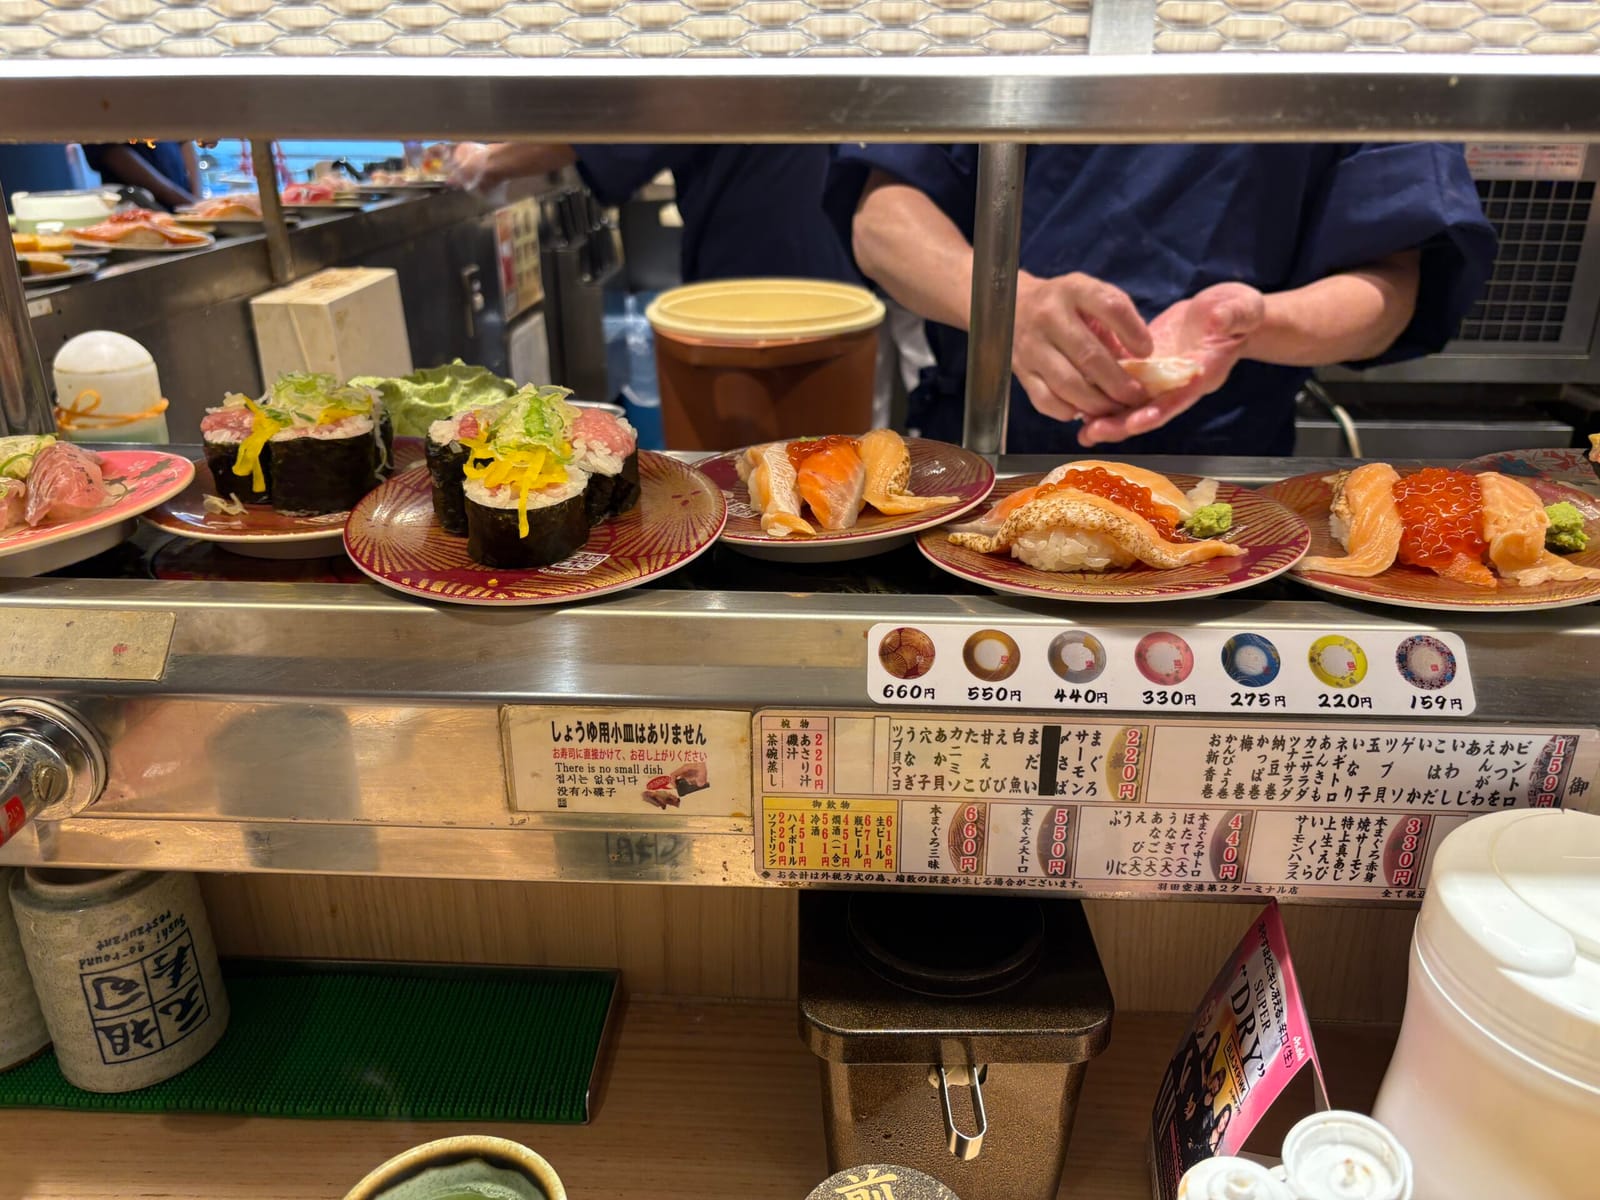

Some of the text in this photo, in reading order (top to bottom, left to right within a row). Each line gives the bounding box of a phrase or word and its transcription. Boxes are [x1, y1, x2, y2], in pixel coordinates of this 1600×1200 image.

[882, 683, 935, 700] 660円
[967, 686, 1021, 702] 550円
[1054, 688, 1108, 704] 440円
[1142, 690, 1197, 707] 330円
[1229, 692, 1286, 708] 275円
[1317, 693, 1373, 709] 220円
[1409, 694, 1463, 711] 159円
[550, 720, 707, 746] しょうゆ用小皿はありません
[552, 747, 708, 763] お寿司に直接かけて、お召し上がりください
[766, 733, 779, 787] 茶碗蒸し
[786, 734, 799, 760] 磯汁
[799, 734, 812, 787] あさり汁
[814, 733, 824, 790] 220円
[891, 725, 903, 791] ツブ貝マヨ
[904, 726, 917, 791] うなぎ
[918, 727, 932, 791] 穴子
[933, 727, 948, 791] あか貝
[947, 726, 963, 792] カニミソ
[963, 727, 979, 793] たこ
[979, 728, 994, 793] 甘えび
[993, 728, 1008, 793] えび
[1009, 727, 1025, 794] 白魚
[1024, 729, 1041, 795] まだい
[1072, 729, 1089, 796] サーモン
[1085, 729, 1103, 797] まぐろ
[1119, 730, 1140, 798] 220円
[1201, 733, 1222, 799] お新香巻
[555, 762, 664, 776] There is no small dish
[557, 786, 617, 798] 没有小碟子
[594, 775, 639, 787] 없습니다
[1217, 733, 1238, 800] かんぴょう巻
[1232, 734, 1254, 800] 梅巻
[1247, 734, 1269, 800] かっぱ巻
[1263, 734, 1286, 801] 納豆巻
[1279, 735, 1301, 801] ツナサラダ
[1295, 735, 1317, 802] カニサラダ
[1311, 734, 1332, 802] あんきも
[1326, 736, 1348, 802] ネギトロ
[1344, 737, 1365, 803] いなり
[1357, 737, 1381, 803] 玉子
[1373, 737, 1398, 804] ツブ貝
[1391, 737, 1416, 804] ゲソ
[1406, 738, 1433, 804] いか
[1421, 738, 1446, 805] こはだ
[1440, 739, 1466, 806] いわし
[1456, 739, 1481, 806] あじ
[1469, 740, 1495, 807] えんがわ
[1487, 740, 1515, 807] かつを
[1502, 740, 1533, 807] ビントロ
[1536, 738, 1566, 809] 159円
[810, 813, 820, 837] 冷酒
[812, 799, 851, 810] 御飲物
[853, 815, 864, 859] 瓶ビール
[875, 815, 886, 860] 生ビール
[927, 803, 943, 871] 本まぐろ三昧
[767, 813, 777, 866] ソフトドリンク
[778, 811, 787, 866] 220円
[787, 814, 798, 866] ハイボール
[798, 812, 807, 867] 451円
[821, 813, 830, 868] 561円
[842, 813, 850, 868] 451円
[863, 814, 872, 869] 671円
[885, 815, 893, 869] 616円
[960, 805, 978, 872] 660円
[1017, 807, 1034, 874] 本まぐろ大トロ
[1048, 809, 1069, 875] 550円
[1105, 809, 1123, 875] ぶり
[1116, 811, 1132, 875] うに
[1143, 811, 1163, 877] あなご（大）
[1158, 812, 1178, 878] うなぎ（大）
[1174, 812, 1196, 878] ほたて（大）
[1191, 812, 1210, 877] 本まぐろ中トロ
[1219, 814, 1242, 879] 440円
[1284, 814, 1309, 881] サーモンハラス
[1302, 815, 1324, 880] いくら
[1314, 815, 1337, 881] 上生えび
[1332, 815, 1354, 881] 特上真あじ
[1348, 816, 1371, 882] 焼サーモン
[1363, 815, 1388, 883] 本まぐろ赤身
[1393, 818, 1421, 885] 330円
[79, 913, 186, 970] Sushi go-round
[96, 908, 172, 952] restaurant
[1254, 978, 1271, 1034] SUPER
